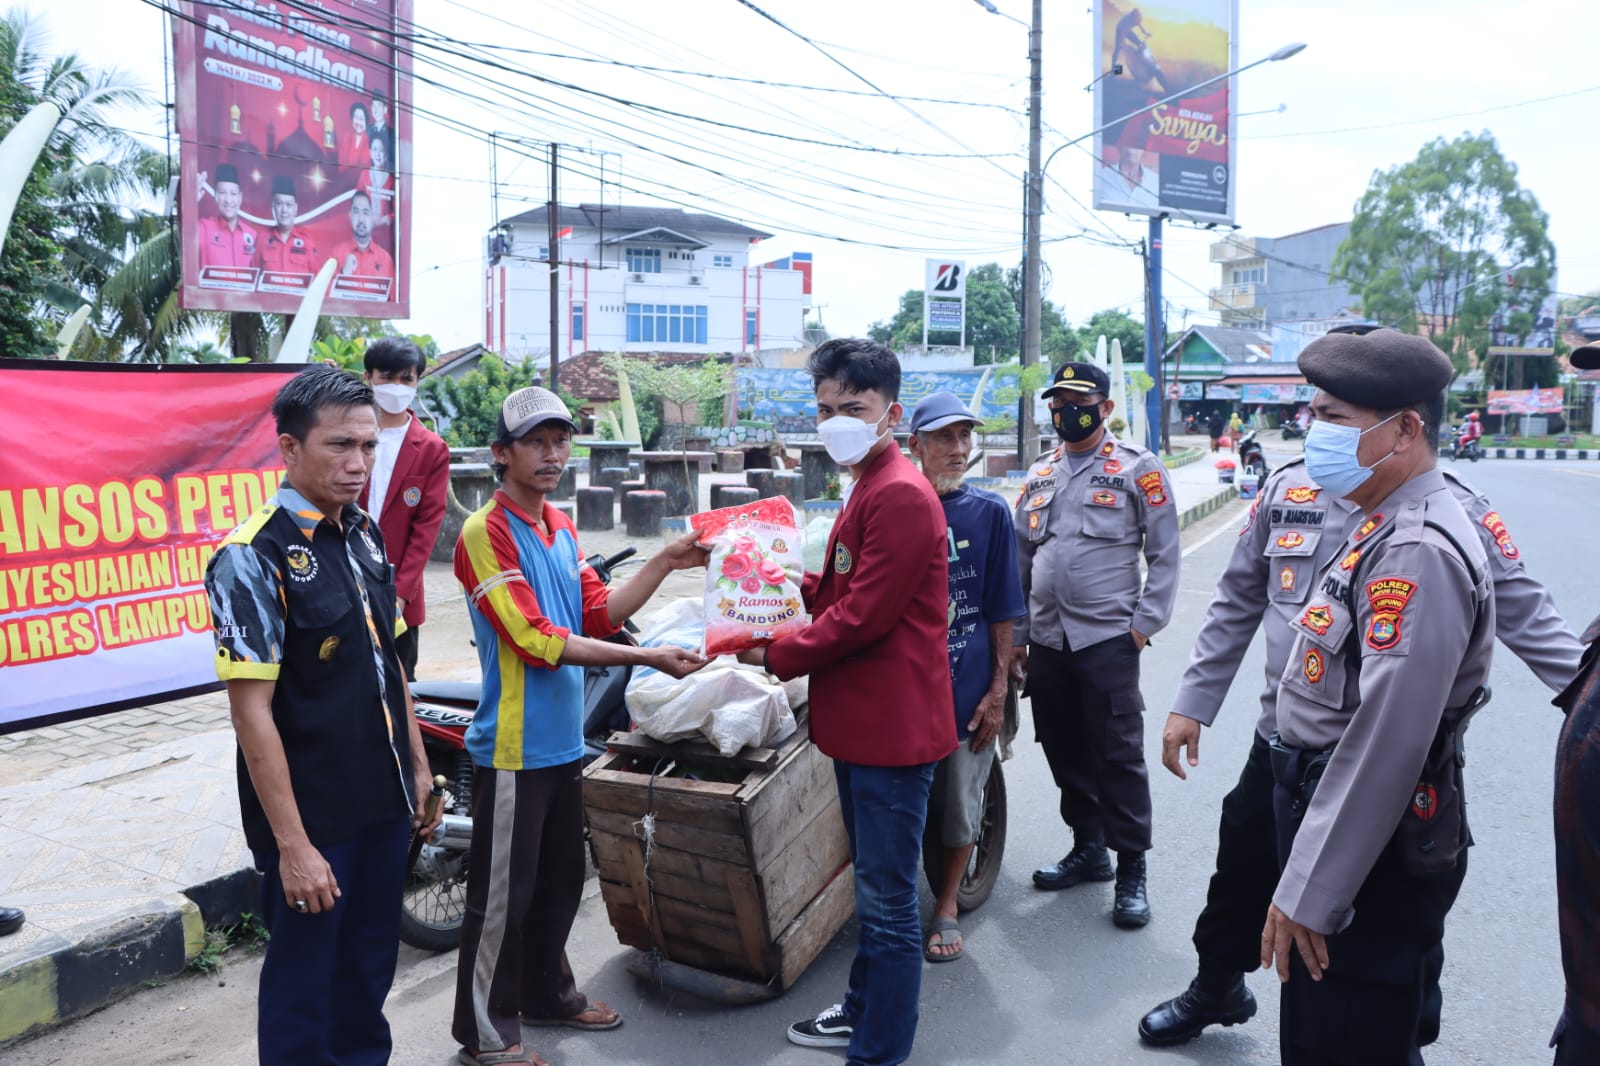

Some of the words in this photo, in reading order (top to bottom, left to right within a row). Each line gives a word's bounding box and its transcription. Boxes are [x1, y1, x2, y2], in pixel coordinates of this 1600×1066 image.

[203, 14, 366, 93] Ramadhan
[1149, 104, 1226, 155] Surya
[1090, 475, 1124, 488] POLRI
[1371, 581, 1410, 593] POLRES
[739, 596, 783, 608] Ramos
[727, 608, 795, 624] BANDUNG
